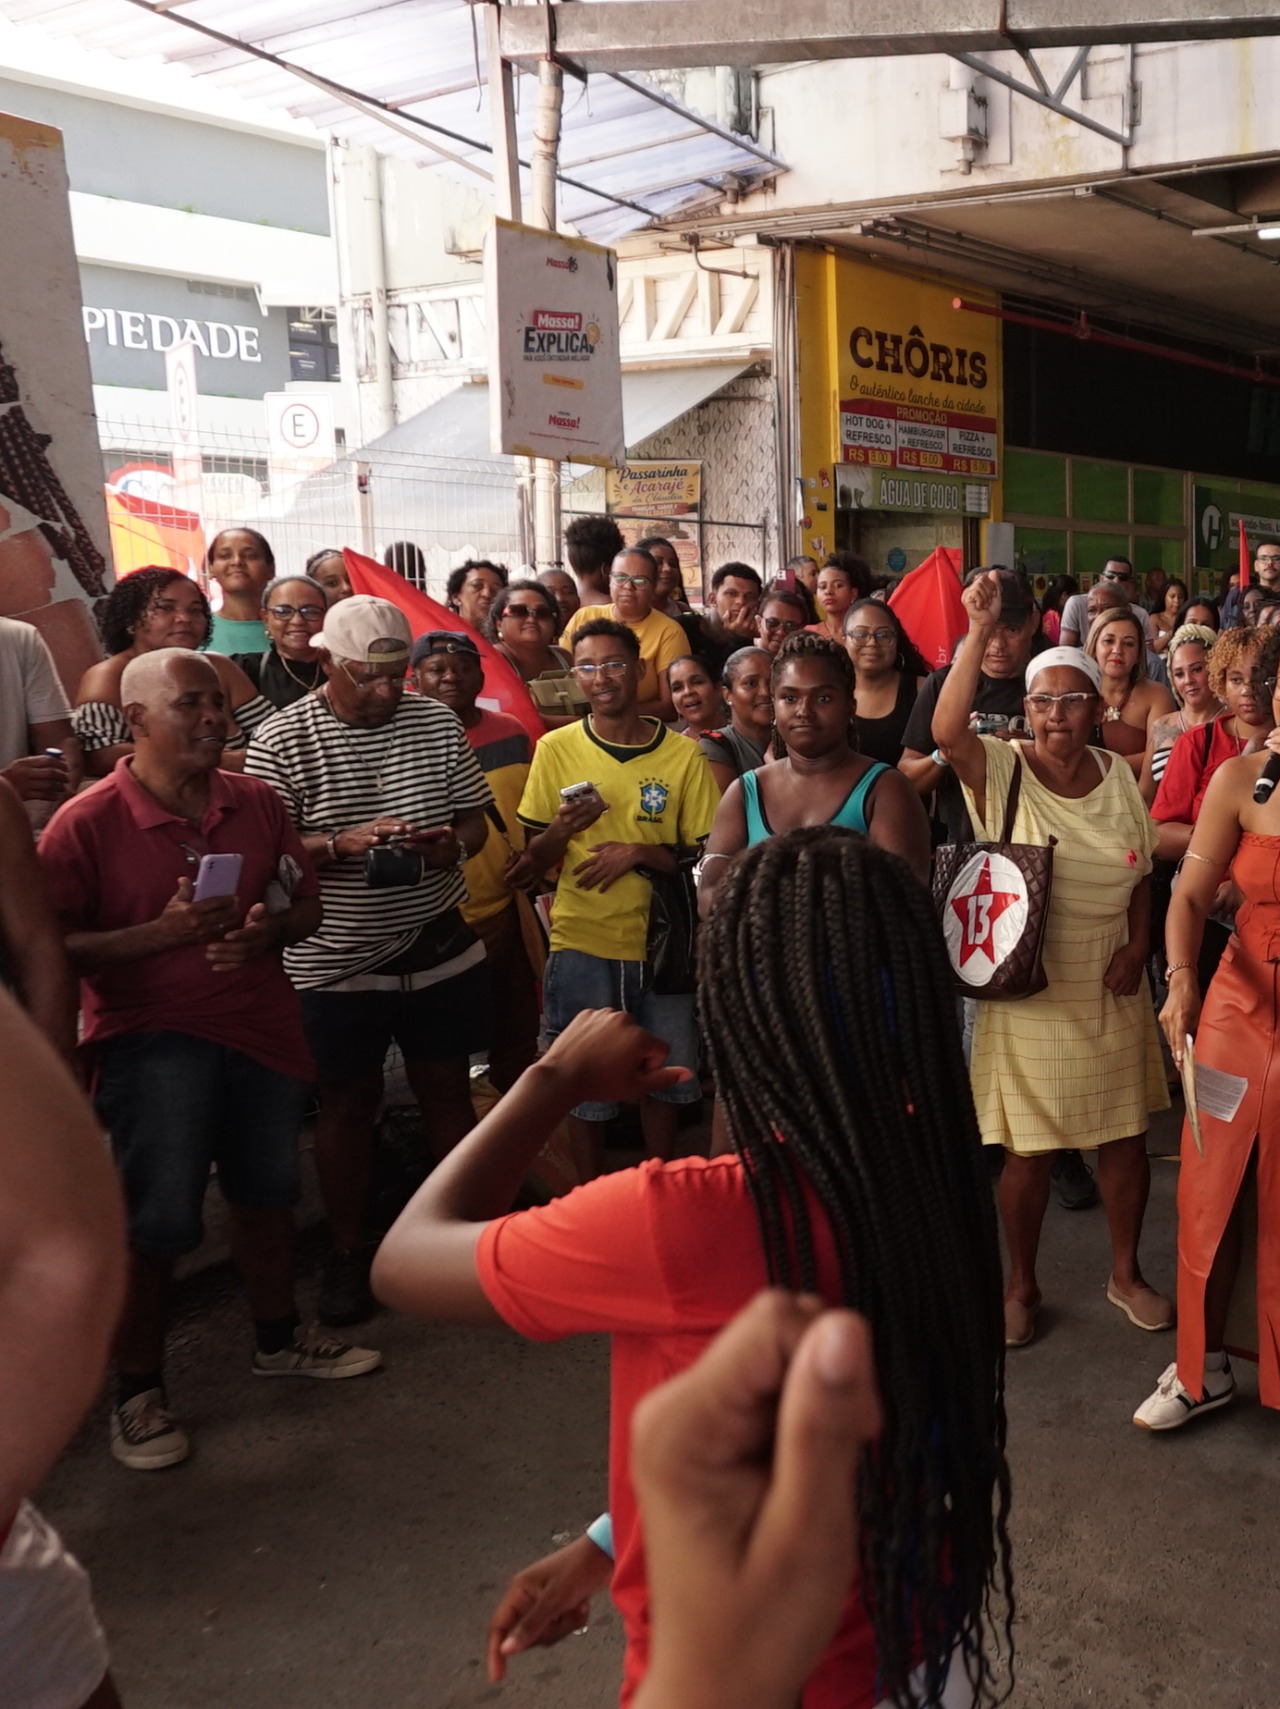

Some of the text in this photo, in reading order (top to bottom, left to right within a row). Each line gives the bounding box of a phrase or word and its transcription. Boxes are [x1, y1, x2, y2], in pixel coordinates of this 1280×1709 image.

[537, 313, 579, 329] Massa!
[82, 306, 262, 362] PIEDADE
[850, 325, 987, 389] CHÔRIS
[908, 388, 940, 408] lanche
[942, 396, 954, 409] da
[957, 399, 986, 414] cidade
[845, 415, 863, 427] HOT
[866, 418, 884, 430] DOG
[896, 406, 947, 425] PROMOÇÃO
[292, 413, 305, 437] E
[846, 429, 891, 445] REFRESCO
[907, 438, 943, 450] REFRESCO
[959, 431, 980, 441] PIZZA
[848, 448, 865, 462] R$
[902, 451, 918, 465] R$
[952, 443, 992, 457] REFRESCO
[953, 459, 968, 471] R$
[617, 465, 688, 483] Passarinha
[629, 478, 685, 495] Acarajé
[880, 472, 911, 507] ÁGUA
[913, 481, 927, 508] DE
[930, 484, 959, 510] COCO
[637, 815, 664, 824] BRASIL
[967, 893, 994, 945] 13
